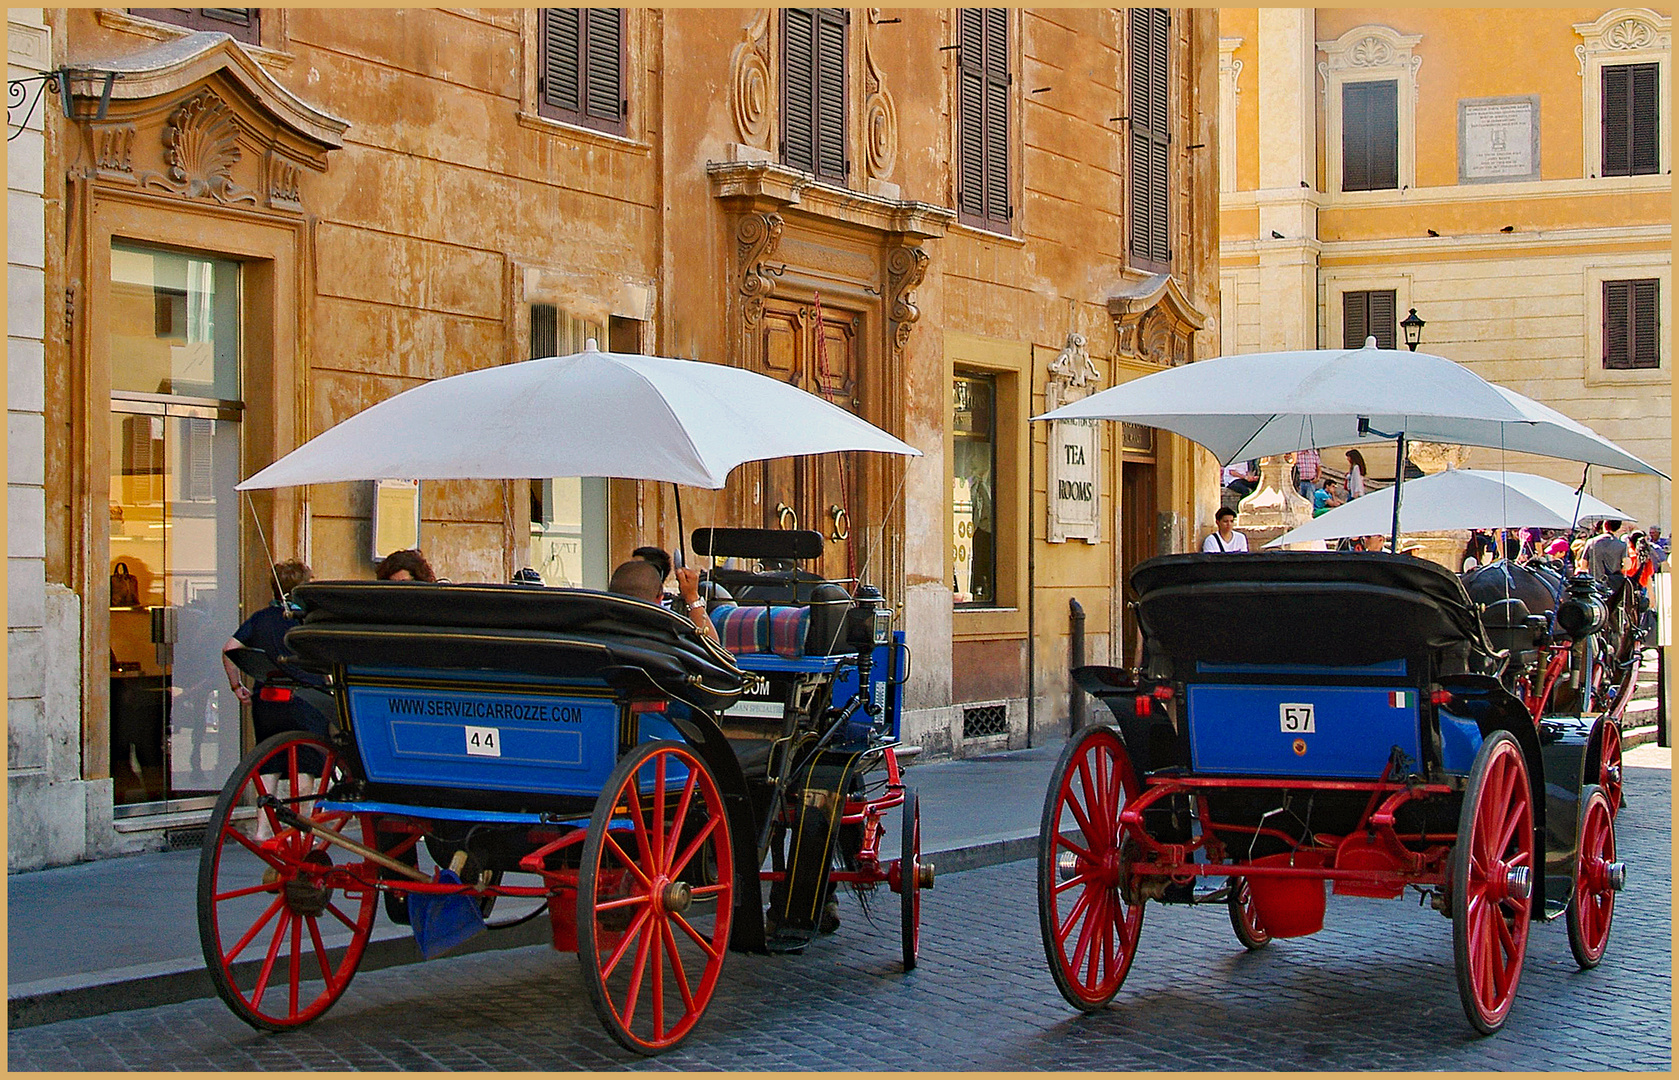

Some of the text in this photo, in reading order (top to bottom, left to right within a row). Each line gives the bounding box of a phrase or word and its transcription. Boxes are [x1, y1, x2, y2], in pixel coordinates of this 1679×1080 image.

[1064, 444, 1085, 465] TEA
[1058, 479, 1092, 501] ROOMS
[388, 698, 582, 723] WWW.SERVIZICARROZZE.COM
[1285, 708, 1311, 730] 57
[470, 732, 494, 748] 44
